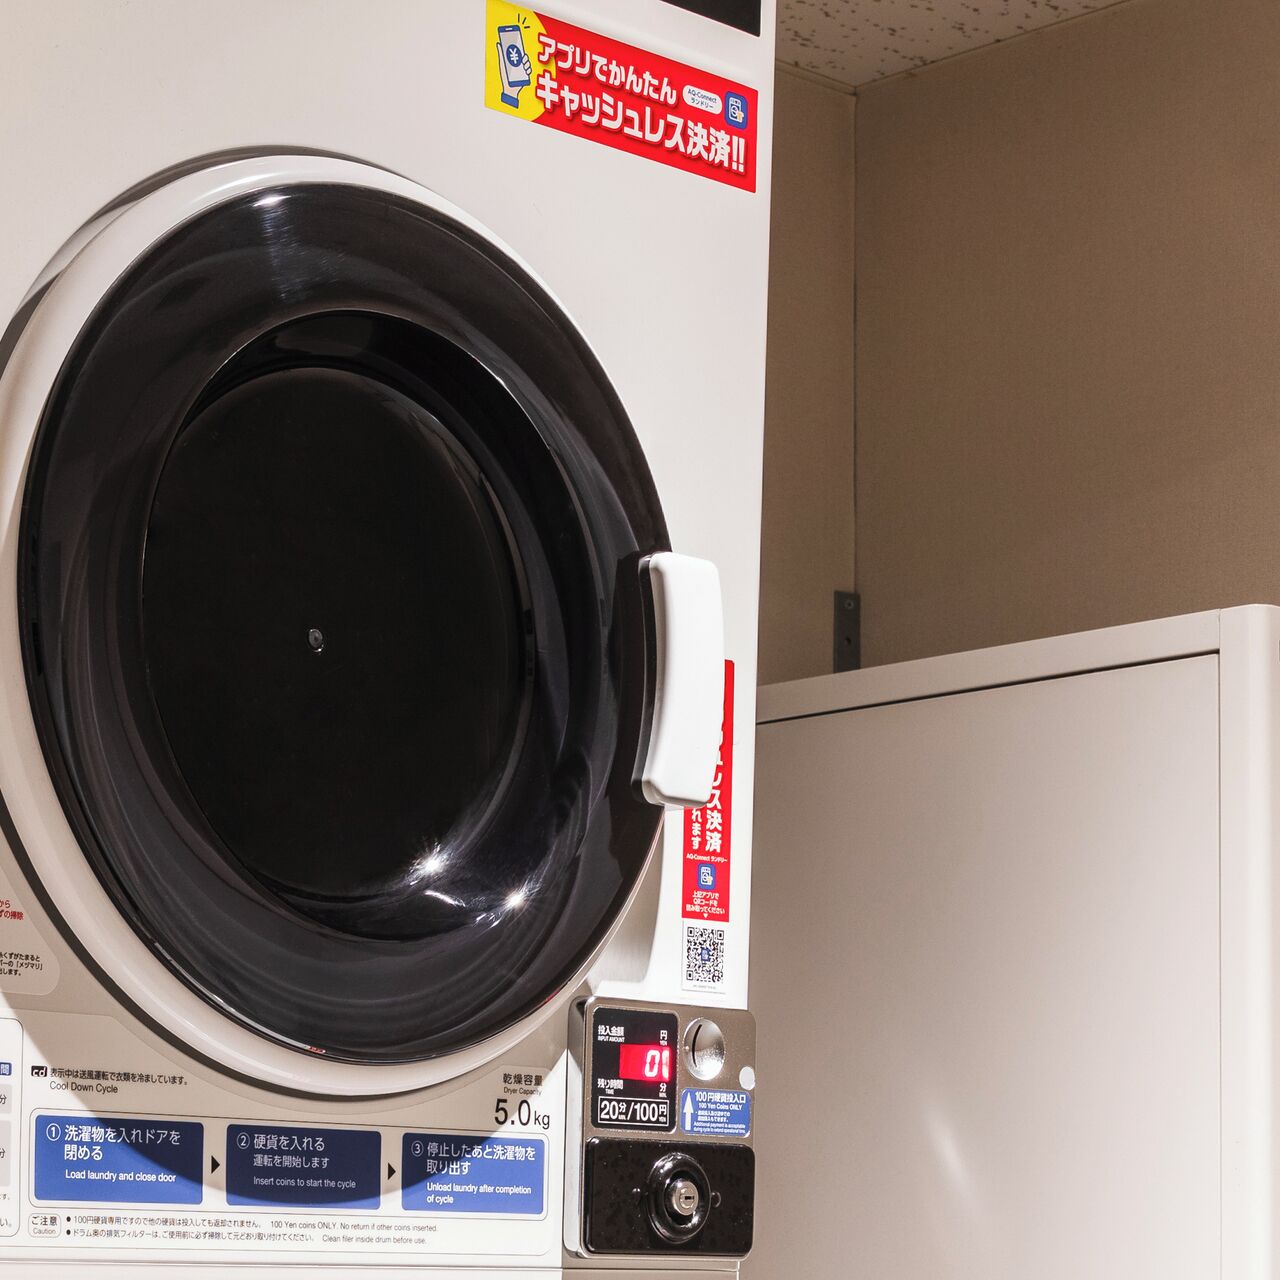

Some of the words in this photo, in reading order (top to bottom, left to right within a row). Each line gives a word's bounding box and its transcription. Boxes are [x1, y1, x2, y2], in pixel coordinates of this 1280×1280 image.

[538, 35, 677, 105] アプリでかんたん
[691, 97, 714, 108] ランドリー
[536, 72, 745, 173] キャッシュレス決済!!
[598, 1025, 624, 1036] 投入金額
[660, 1030, 667, 1040] 円
[50, 1067, 188, 1086] 表示中は送風運転で衣類を冷ましています。
[503, 1073, 542, 1086] 乾燥容量
[50, 1081, 69, 1091] Cool
[71, 1082, 93, 1092] Down
[96, 1083, 118, 1094] Cycle
[598, 1079, 623, 1089] 残り時間
[660, 1083, 667, 1092] 分
[504, 1087, 518, 1095] Dryer
[519, 1088, 541, 1096] Capacity
[695, 1091, 746, 1104] 100円硬貨投入口
[64, 1124, 181, 1145] 洗濯物を入れドアを
[253, 1133, 325, 1152] 硬貨を入れる
[64, 1145, 103, 1161] 閉める
[427, 1142, 535, 1161] 停止したあと洗濯物を
[253, 1154, 329, 1169] 運転を開始します
[426, 1160, 471, 1175] 取り出す
[65, 1169, 85, 1180] Load
[87, 1170, 117, 1182] laundry
[119, 1171, 134, 1181] and
[136, 1172, 156, 1181] close
[158, 1172, 176, 1182] door
[253, 1176, 274, 1187] Insert
[276, 1177, 295, 1187] coins
[297, 1179, 304, 1187] to
[306, 1179, 322, 1188] start
[324, 1179, 336, 1188] the
[337, 1180, 356, 1191] cycle
[427, 1183, 452, 1192] Unload
[453, 1183, 478, 1194] laundry
[479, 1185, 494, 1193] after
[495, 1185, 531, 1196] completion
[427, 1195, 434, 1203] of
[435, 1195, 453, 1205] cycle
[31, 1216, 57, 1227] ご注意
